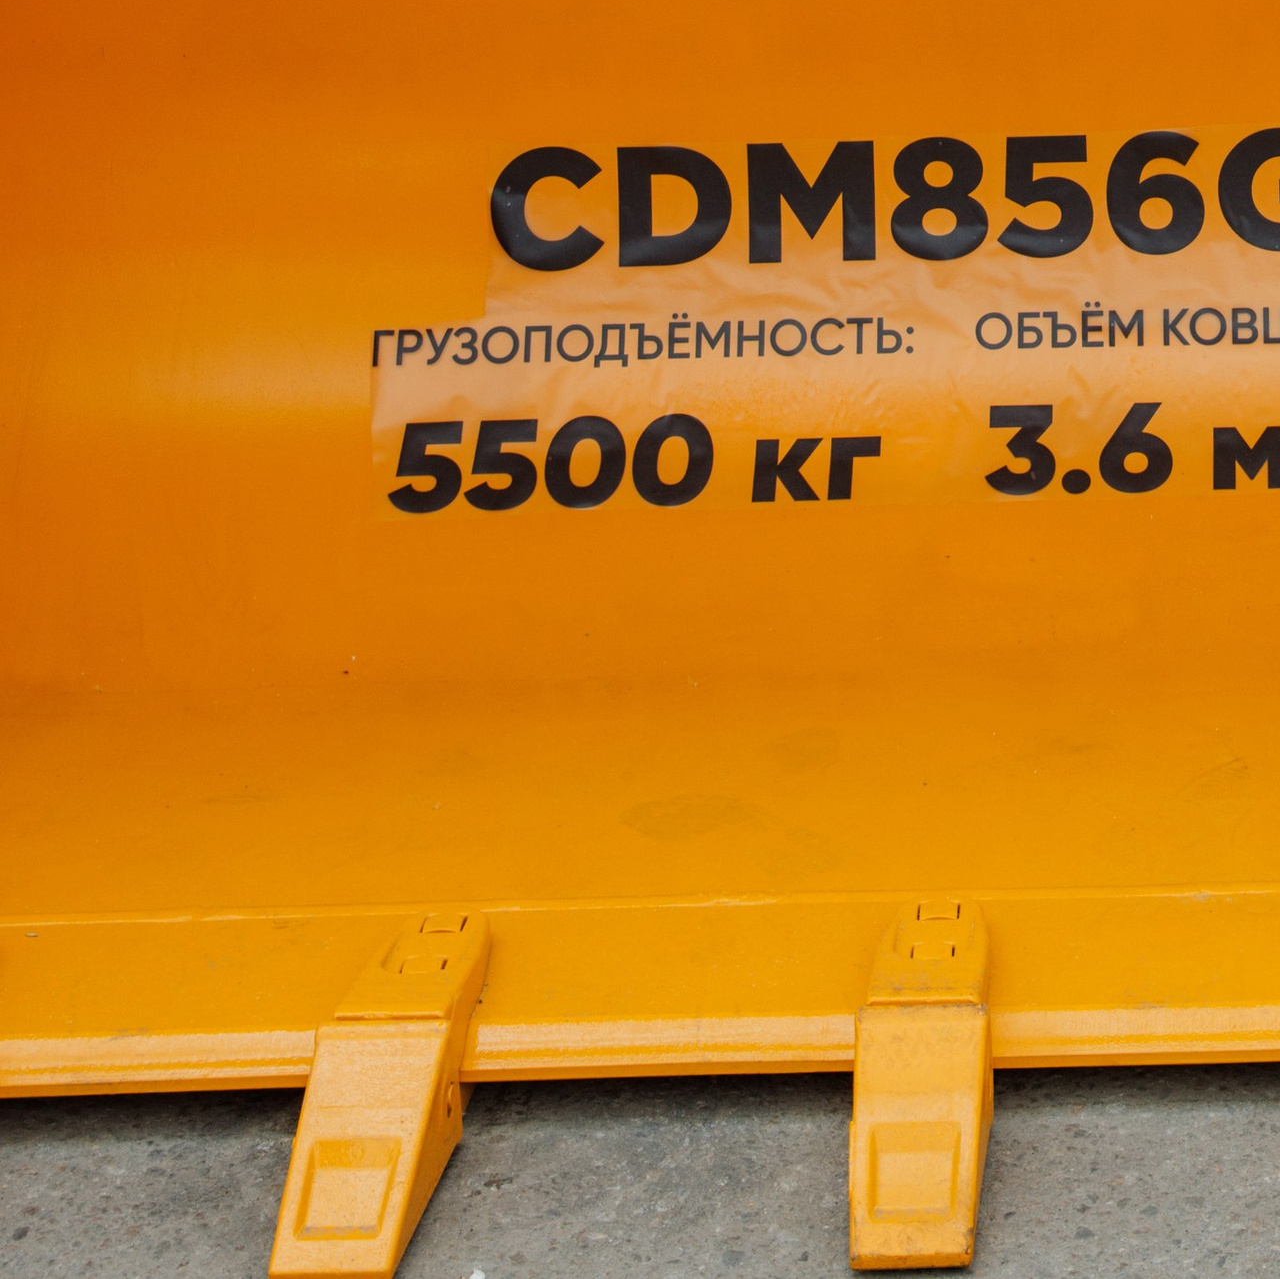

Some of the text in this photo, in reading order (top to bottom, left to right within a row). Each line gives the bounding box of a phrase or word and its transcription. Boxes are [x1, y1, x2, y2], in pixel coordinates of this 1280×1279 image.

[371, 312, 915, 368] ГРУЗОПОДЪЁМНОСТЬ:
[975, 301, 1146, 350] ОБЪЁМ
[388, 413, 882, 513] 5500 кг
[984, 402, 1174, 496] 3.6
